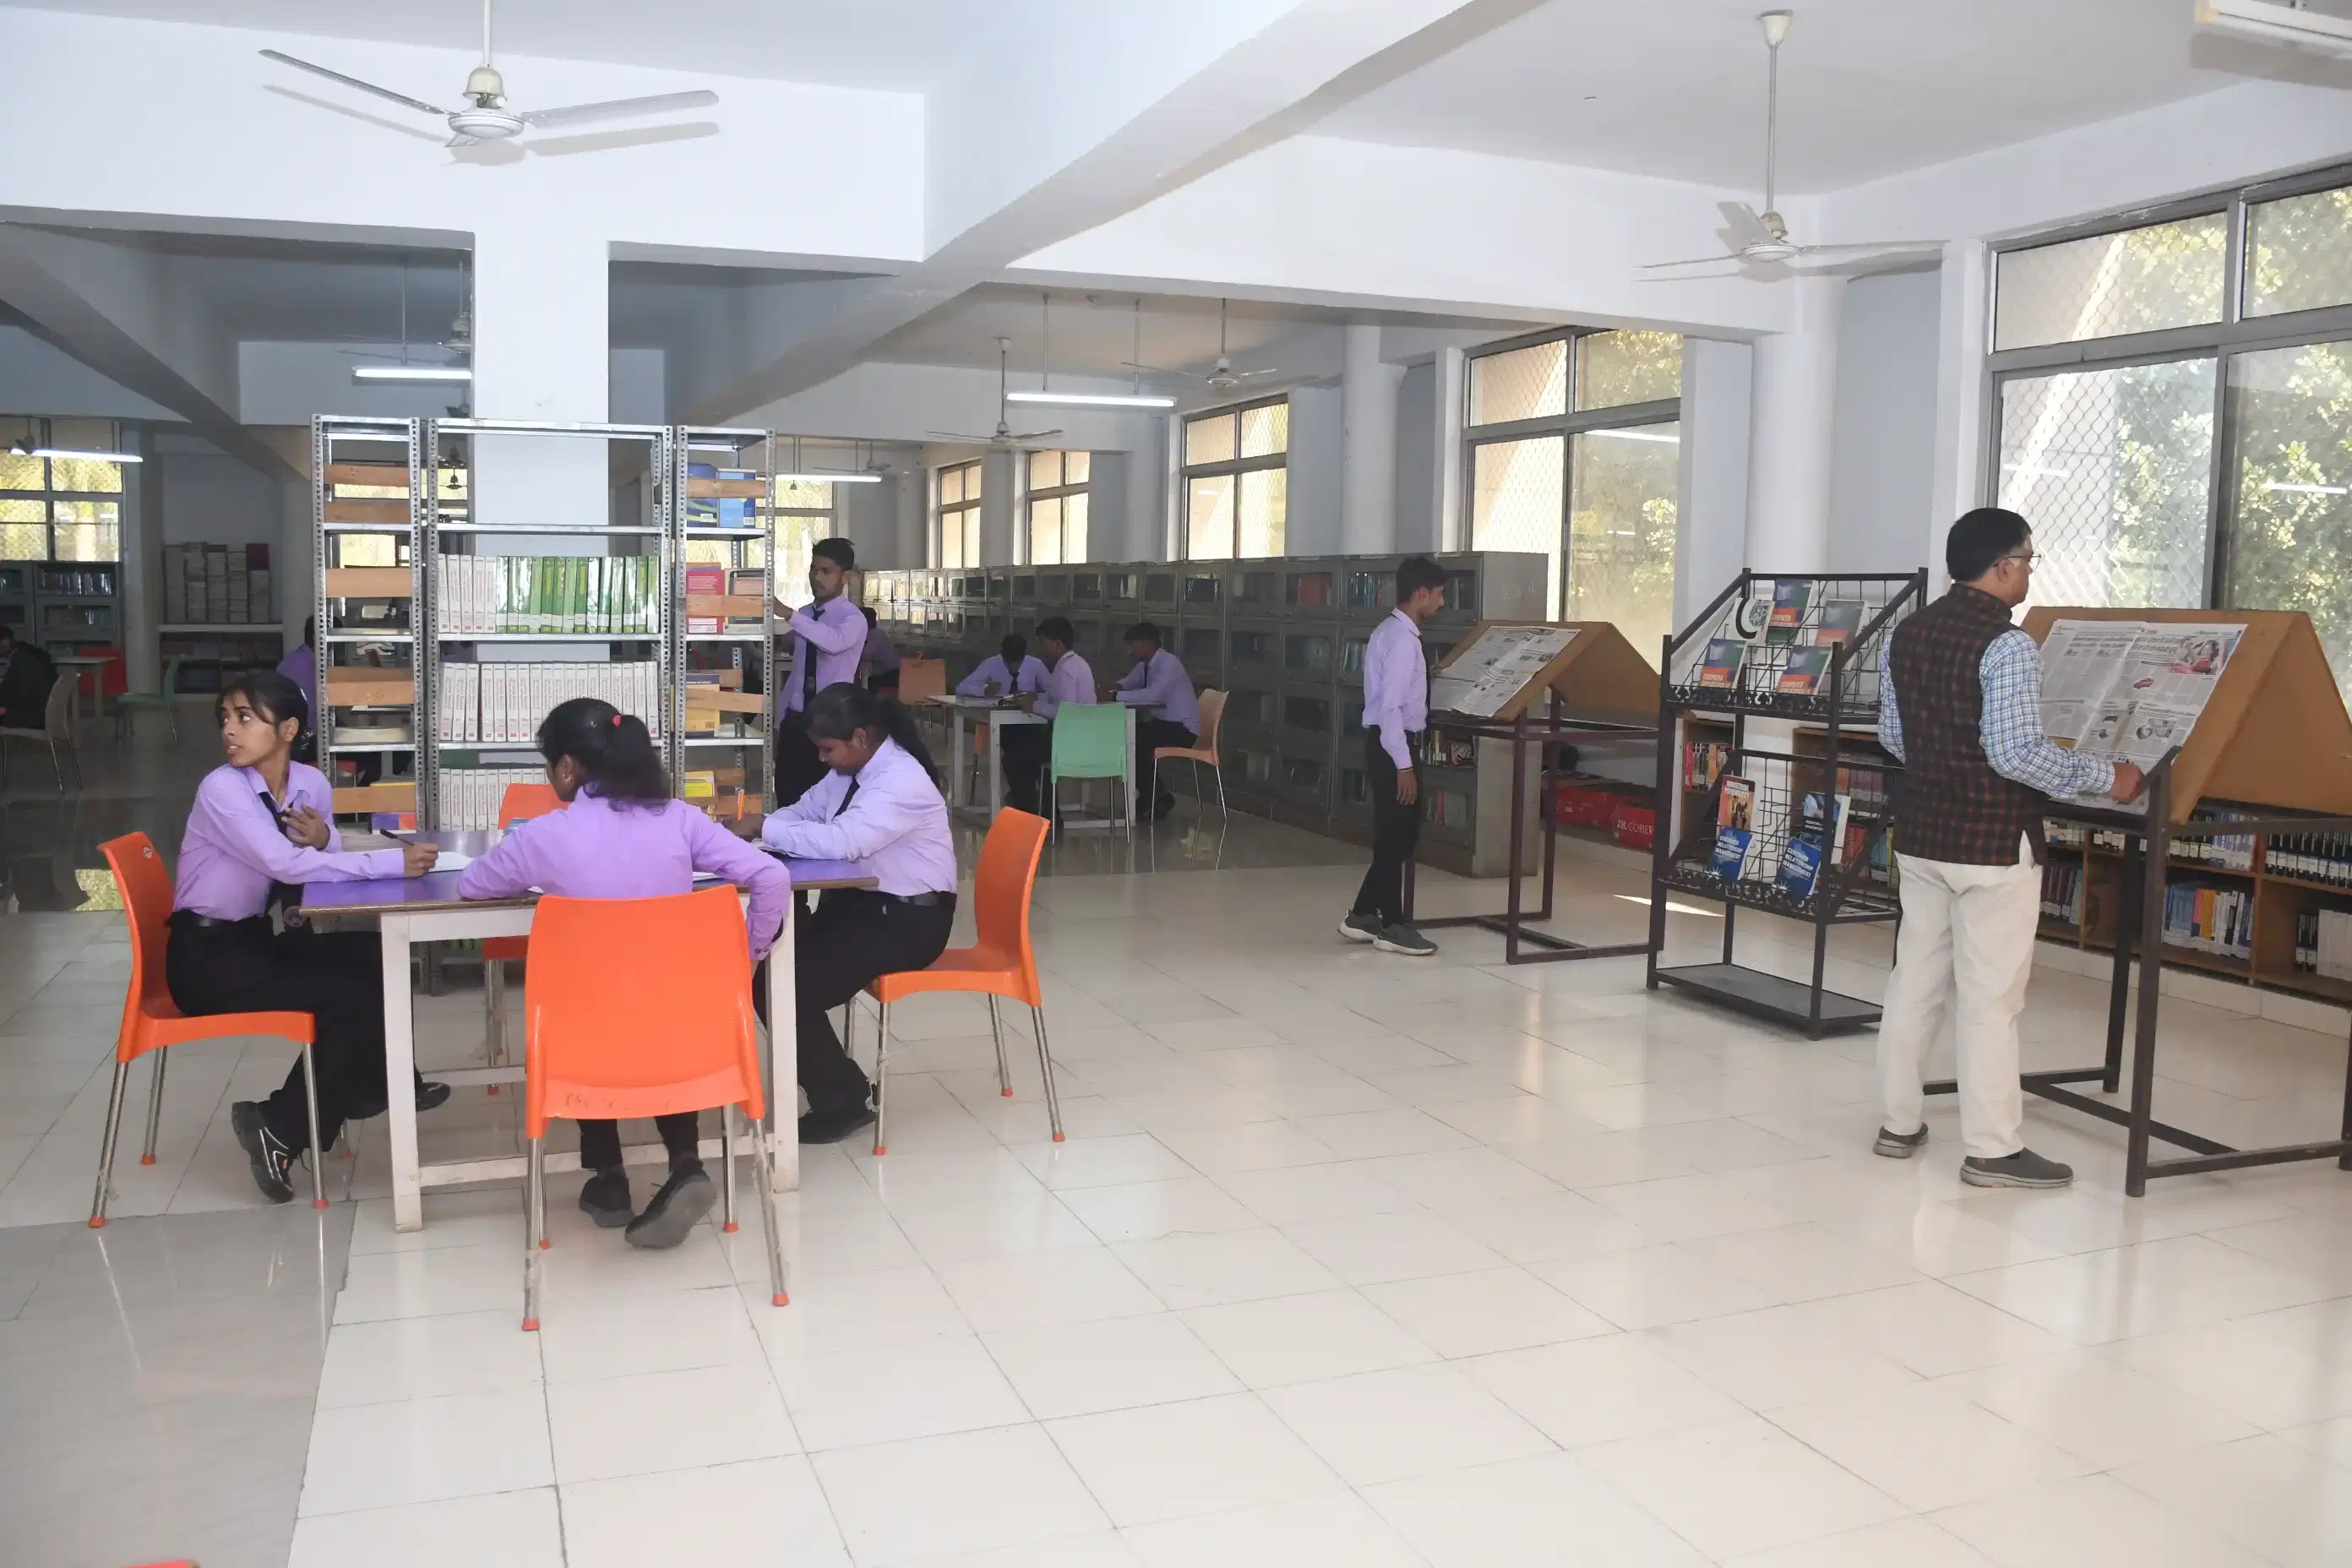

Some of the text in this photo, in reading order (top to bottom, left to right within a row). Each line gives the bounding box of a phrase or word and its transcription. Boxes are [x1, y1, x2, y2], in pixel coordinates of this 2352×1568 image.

[1726, 780, 1749, 792] INDUSTRIAL
[1723, 787, 1749, 798] PSYCHOLOGY
[1627, 821, 1653, 836] COPIER
[1717, 841, 1743, 853] RELATIONSHIP
[1719, 836, 1740, 846] CUSTOMER
[1715, 847, 1741, 859] MANAGEMENT
[1787, 847, 1809, 862] CUSTOMER
[1784, 853, 1814, 871] RELATIONSHIP
[1783, 860, 1811, 878] MANAGEMENT
